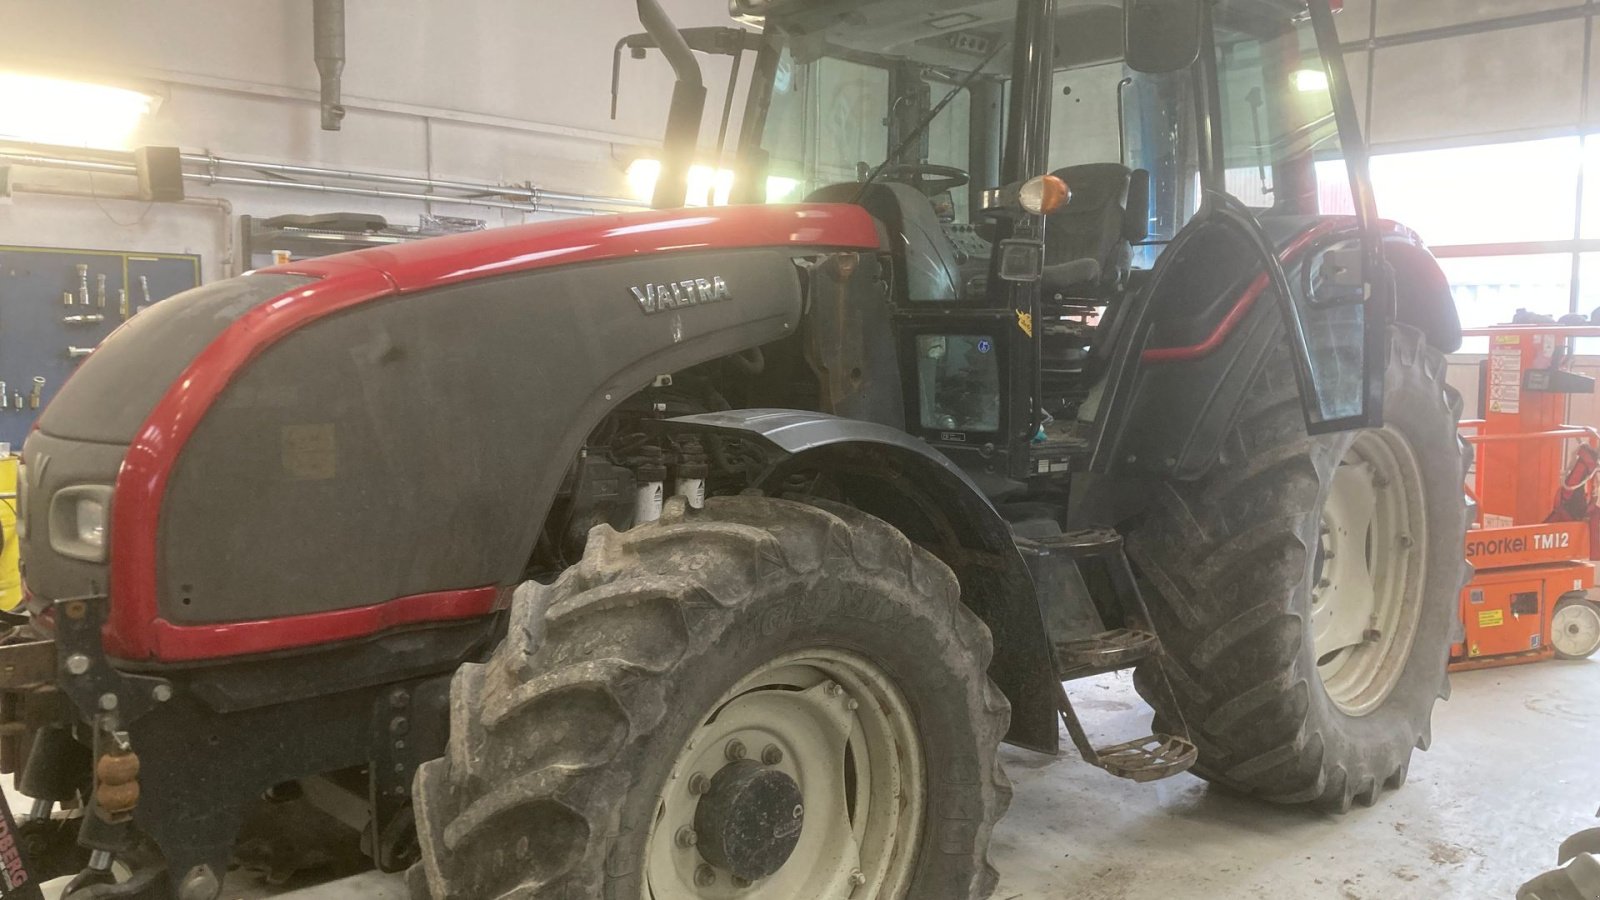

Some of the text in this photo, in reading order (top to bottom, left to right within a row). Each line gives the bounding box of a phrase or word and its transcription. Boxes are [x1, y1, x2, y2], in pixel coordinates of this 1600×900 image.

[629, 276, 732, 314] VALTRA
[1466, 532, 1569, 557] snorkel TM12
